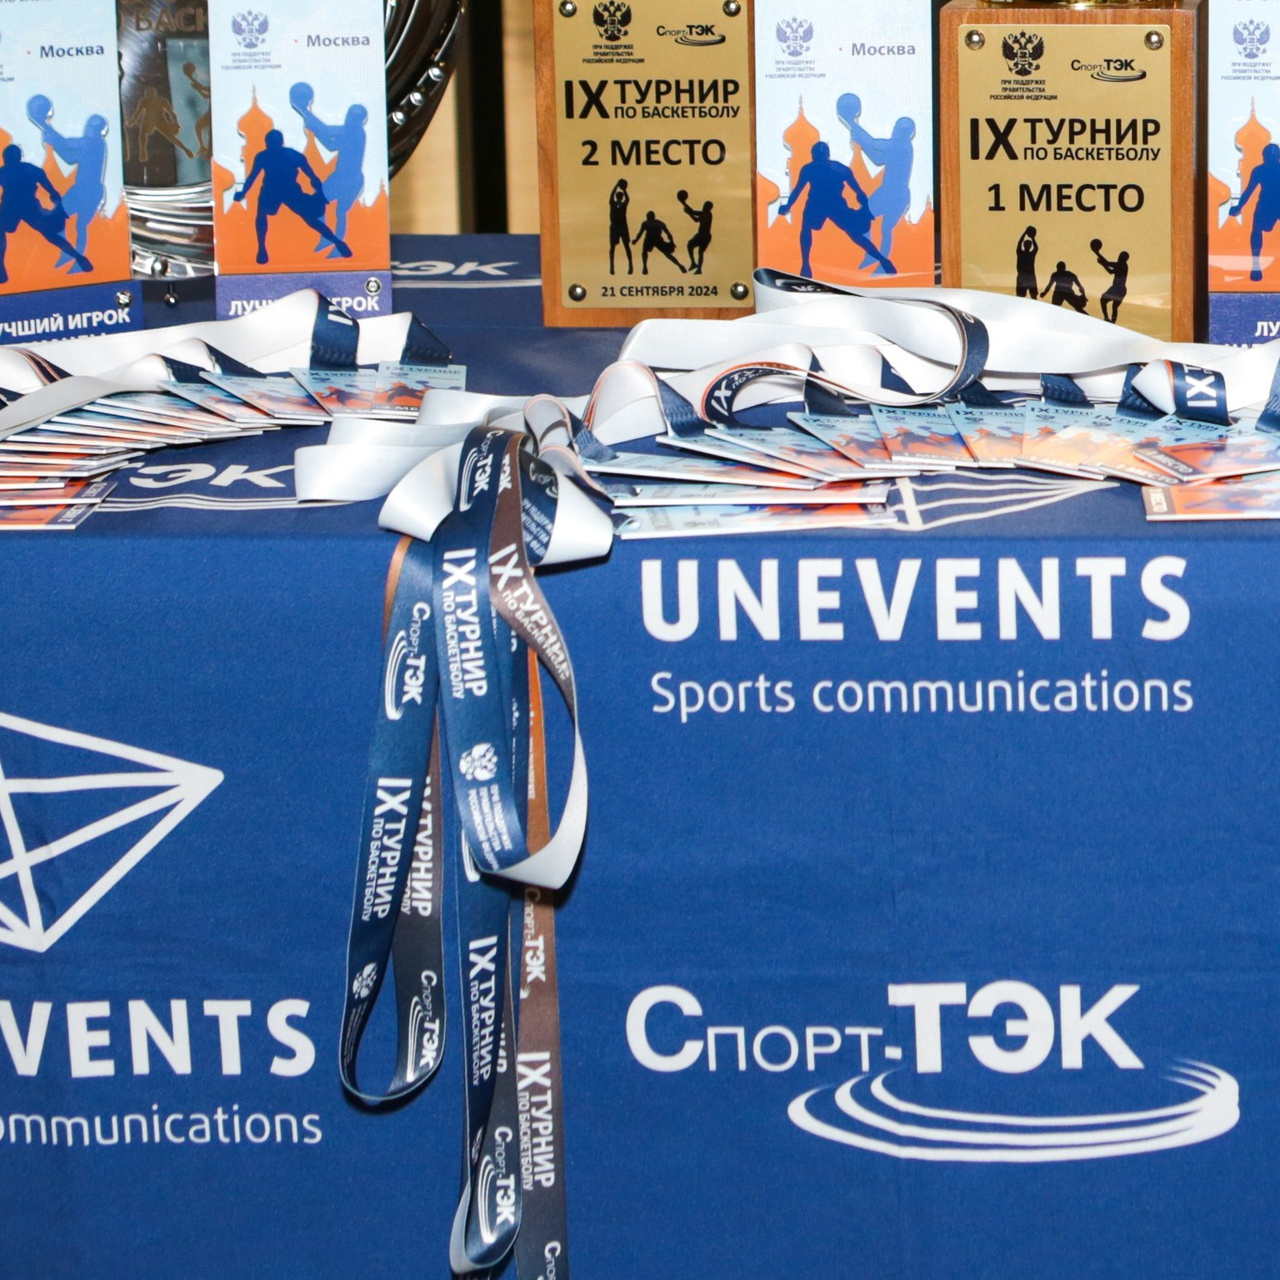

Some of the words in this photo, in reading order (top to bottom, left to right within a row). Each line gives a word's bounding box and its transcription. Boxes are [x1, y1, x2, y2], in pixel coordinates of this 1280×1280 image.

[39, 42, 105, 58] Москва
[306, 34, 371, 48] Москва
[850, 42, 917, 56] Москва
[564, 79, 610, 120] IX
[614, 79, 740, 104] ТУРНИР
[614, 106, 637, 118] ПО
[641, 106, 741, 119] БАСКЕТБОЛУ
[581, 140, 599, 166] 2
[610, 139, 726, 166] МЕСТО
[969, 118, 1018, 161] IX
[1023, 118, 1161, 145] ТУРНИР
[1024, 147, 1047, 160] ПО
[1053, 147, 1161, 161] БАСКЕТБОЛУ
[988, 183, 1006, 212] 1
[1018, 183, 1145, 212] МЕСТО
[601, 286, 616, 297] 21
[620, 286, 685, 297] СЕНТЯБРЯ
[688, 286, 718, 297] 2024
[66, 307, 131, 331] ИГРОК
[711, 379, 733, 417] IX
[1187, 375, 1217, 407] IX
[443, 548, 477, 587] IX
[443, 591, 456, 611] ПО
[488, 543, 524, 591] IX
[513, 579, 571, 679] ТУРНИР
[502, 589, 518, 611] ПО
[641, 556, 1191, 642] UNEVENTS
[443, 614, 466, 700] БАСКЕТБОЛУ
[455, 588, 488, 697] ТУРНИР
[650, 671, 796, 723] Sports
[812, 669, 1194, 714] communications
[374, 777, 413, 816] IX
[371, 817, 385, 839] ПО
[361, 839, 382, 922] БАСКЕТБОЛУ
[372, 817, 407, 919] ТУРНИР
[469, 935, 498, 979] IX
[470, 980, 480, 1002] ПО
[0, 998, 316, 1078] VENTS
[470, 1005, 481, 1086] БАСКЕТБОЛУ
[478, 975, 496, 1080] ТУРНИР
[517, 1051, 551, 1089] IX
[519, 1091, 530, 1111] ПО
[519, 1113, 534, 1191] БАСКЕТБОЛУ
[530, 1089, 554, 1188] ТУРНИР
